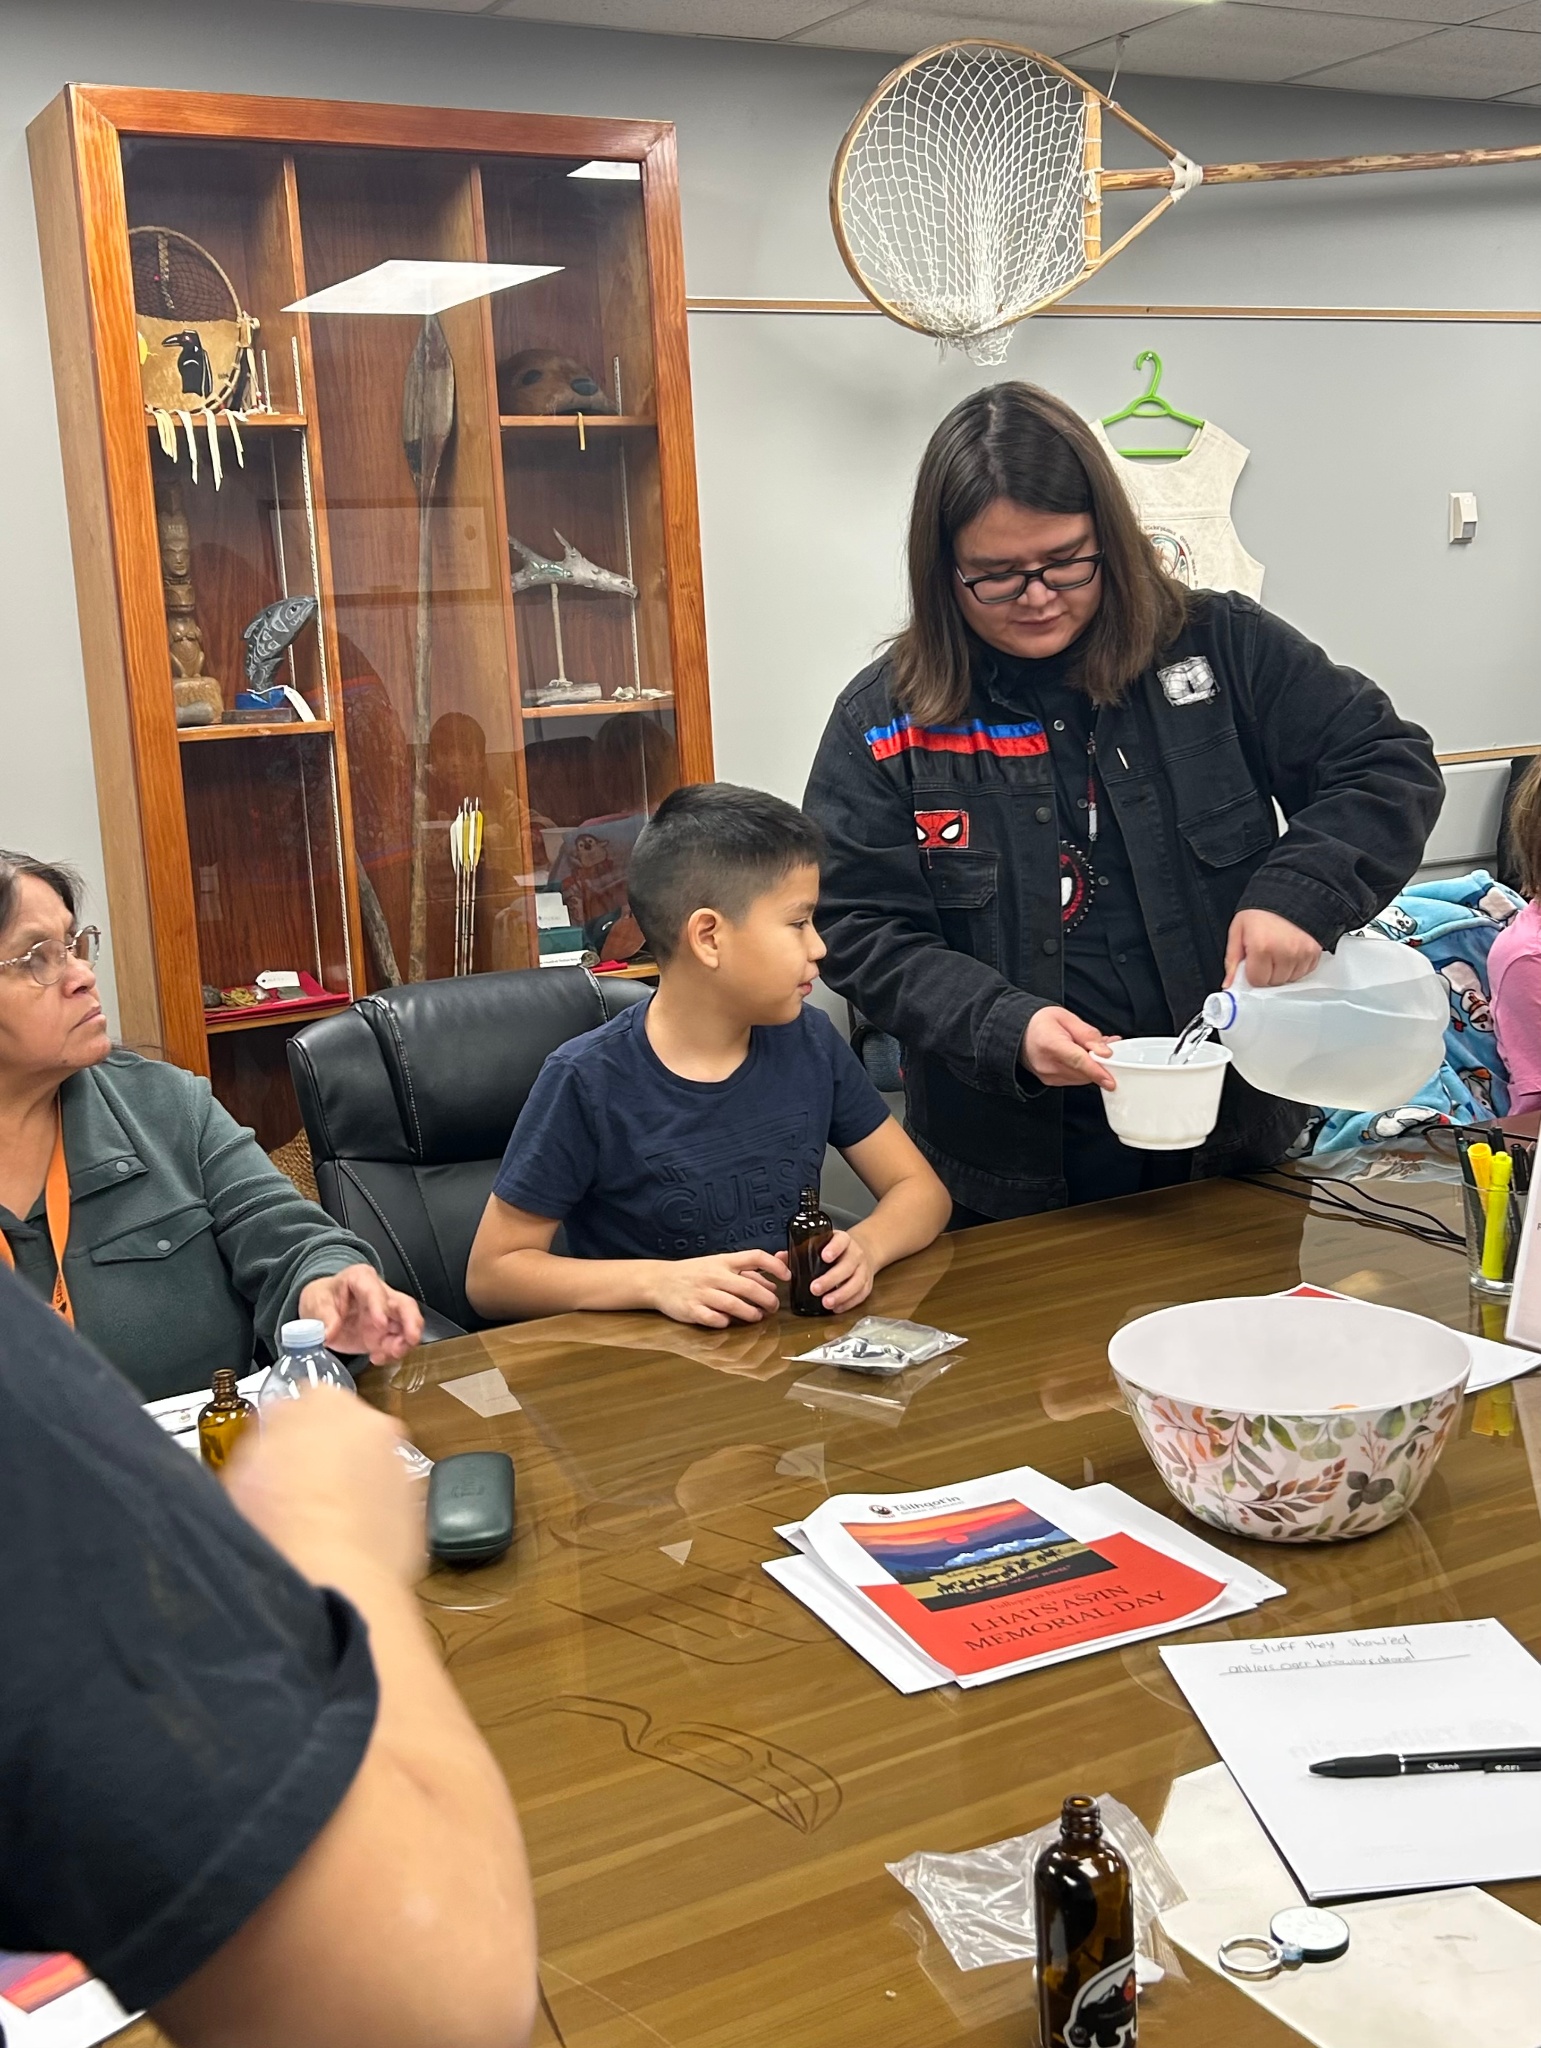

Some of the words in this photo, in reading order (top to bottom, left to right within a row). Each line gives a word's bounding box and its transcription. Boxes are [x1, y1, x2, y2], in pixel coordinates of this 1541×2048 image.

[653, 1147, 821, 1236] GUESS
[726, 1214, 788, 1243] ANGE
[964, 1606, 1115, 1651] MEMORIAL
[1113, 1590, 1168, 1613] DAY
[1305, 1640, 1335, 1651] they
